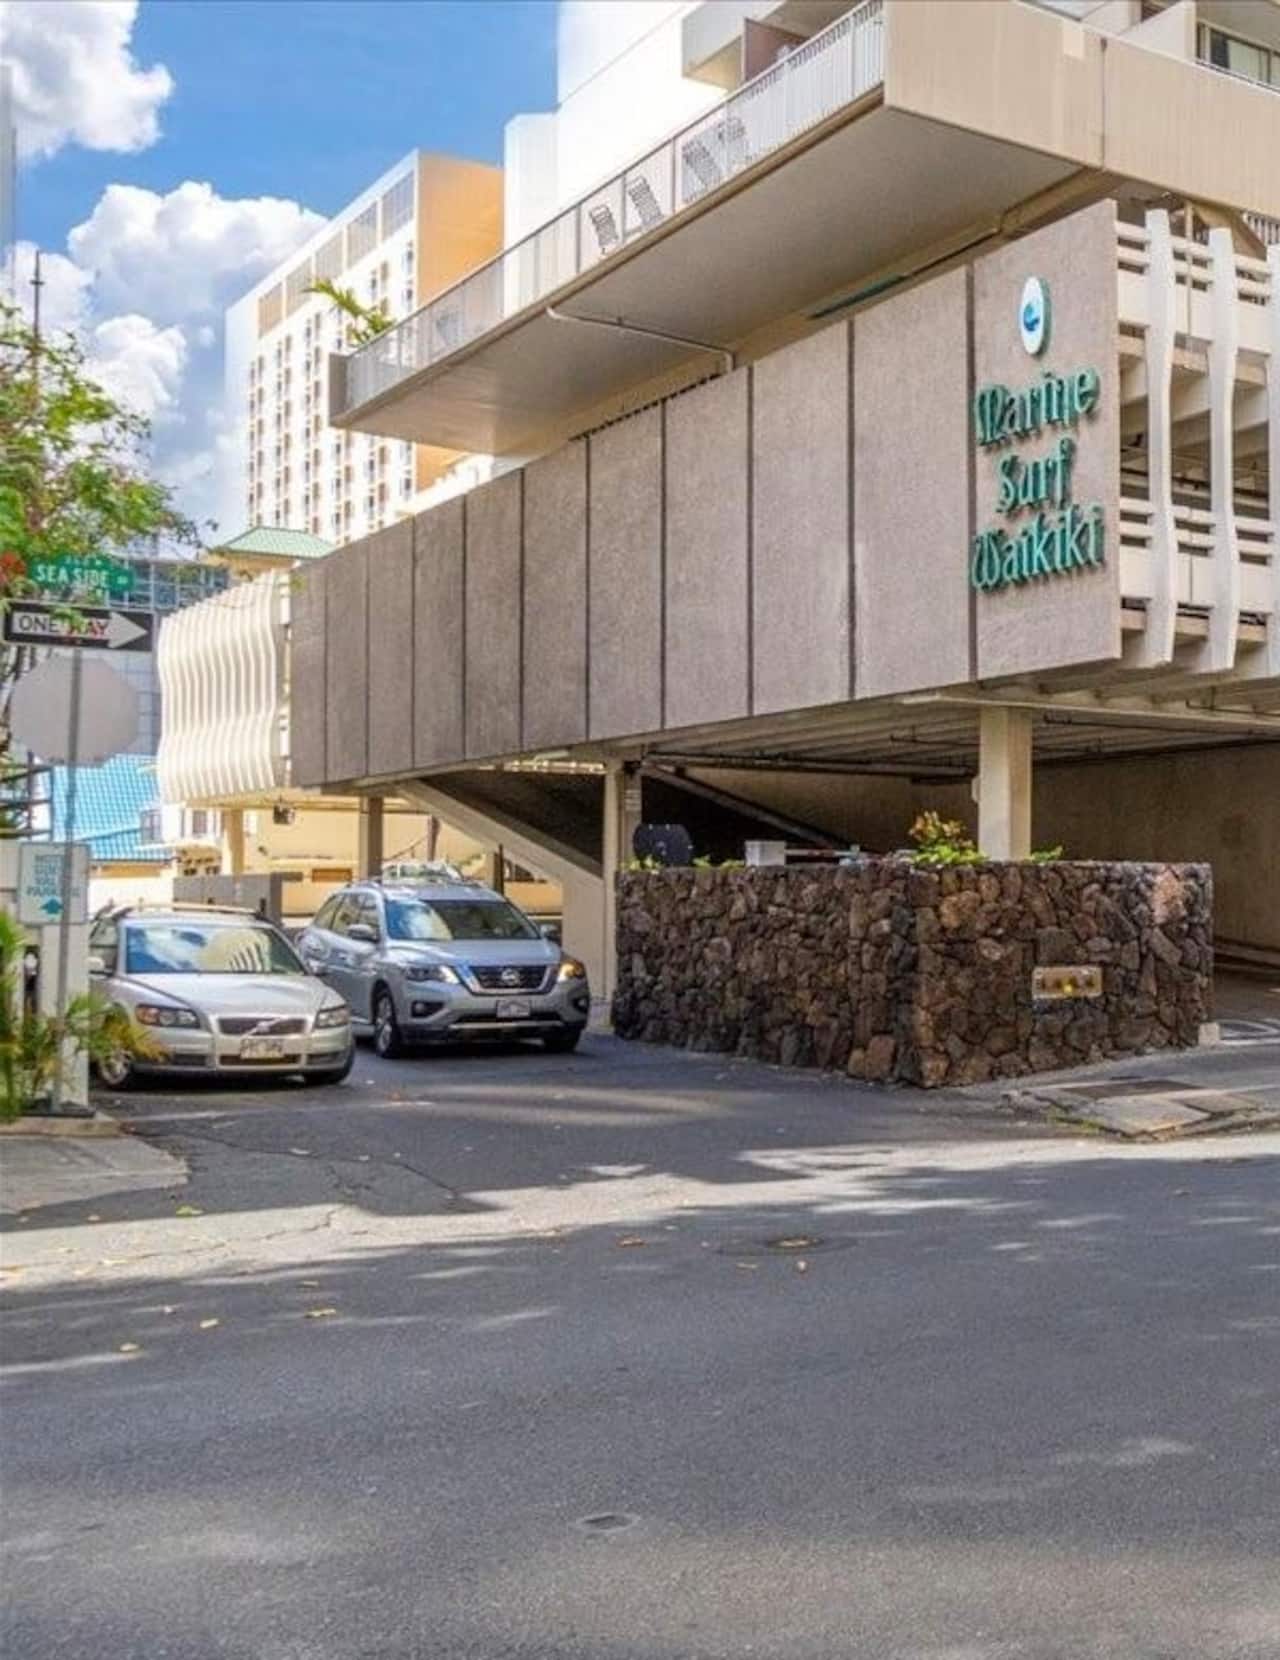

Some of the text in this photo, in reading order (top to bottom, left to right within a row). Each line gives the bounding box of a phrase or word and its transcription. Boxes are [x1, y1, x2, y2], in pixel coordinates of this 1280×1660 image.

[976, 367, 1100, 446] Marine
[996, 436, 1075, 514] Surf
[970, 505, 1106, 592] Waikiki
[18, 614, 60, 634] ONE
